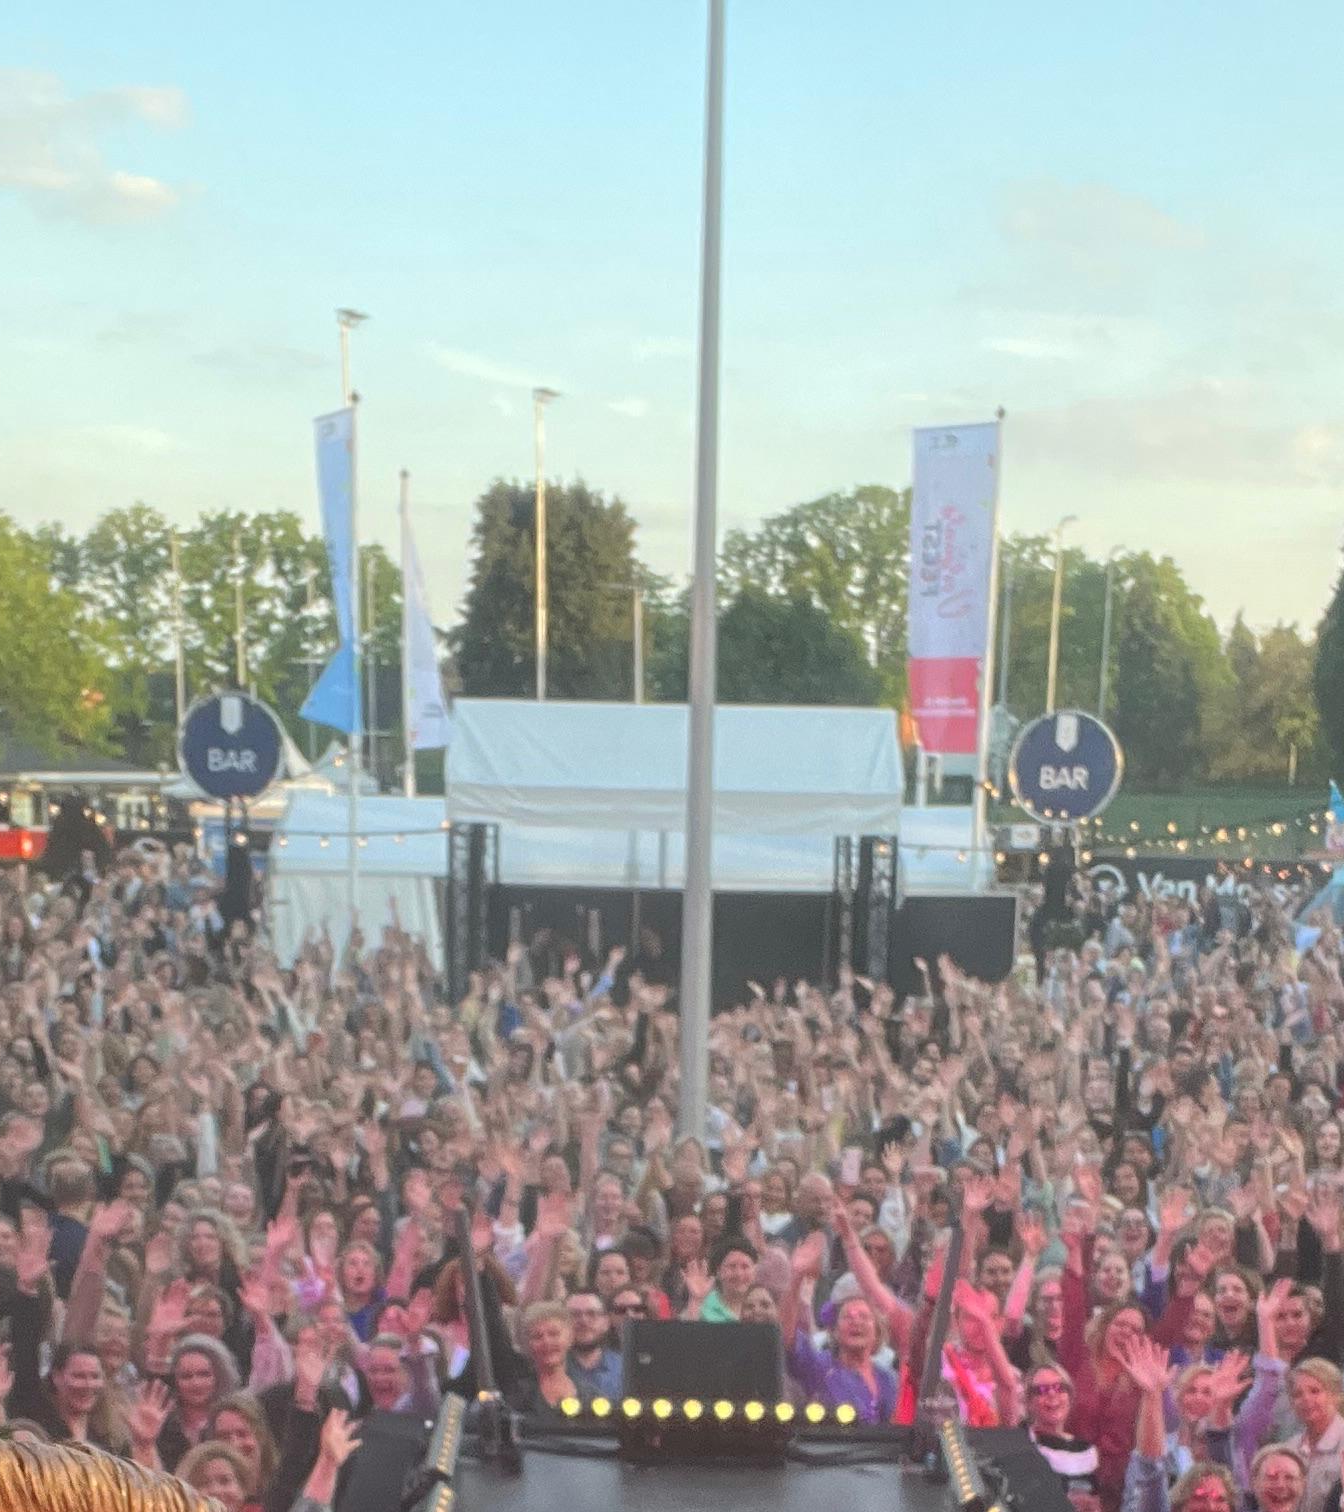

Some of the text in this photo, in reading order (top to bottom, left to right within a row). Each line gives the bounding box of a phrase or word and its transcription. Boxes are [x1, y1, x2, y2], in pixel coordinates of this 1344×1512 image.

[207, 747, 257, 773] BAR
[1039, 765, 1089, 790] BAR
[1137, 871, 1199, 903] Van
